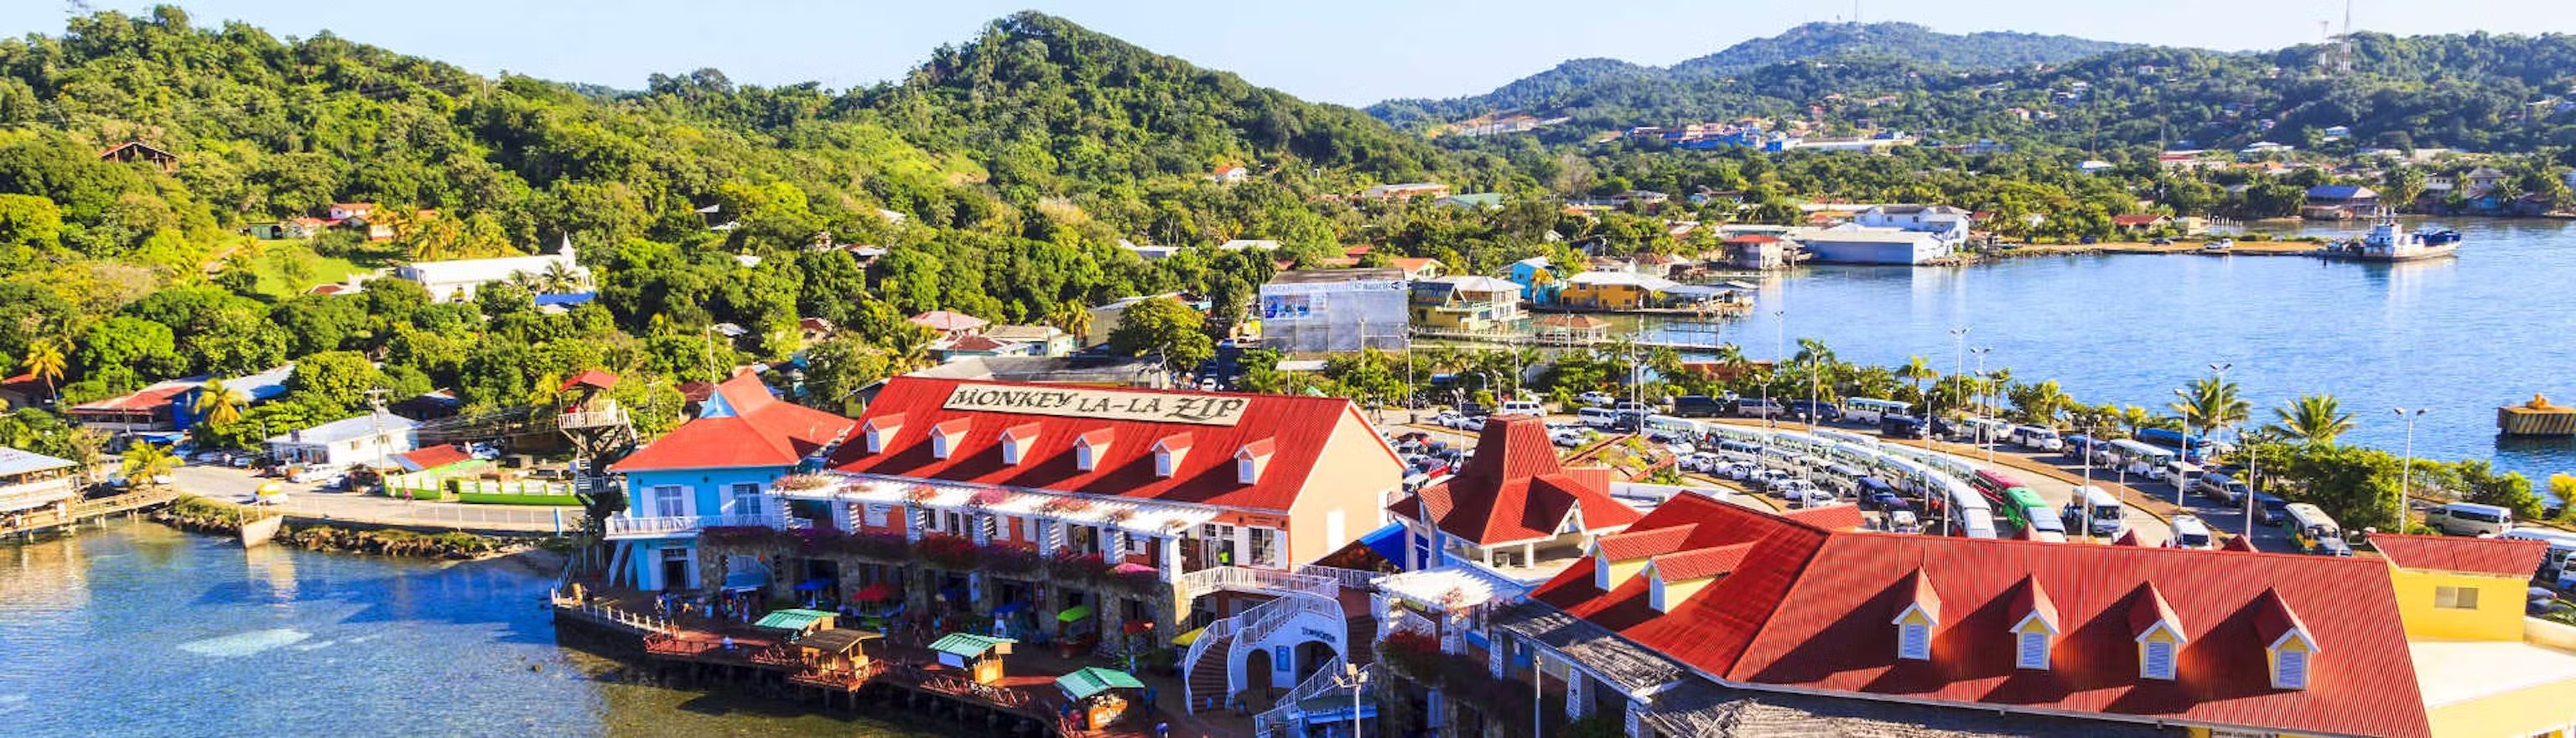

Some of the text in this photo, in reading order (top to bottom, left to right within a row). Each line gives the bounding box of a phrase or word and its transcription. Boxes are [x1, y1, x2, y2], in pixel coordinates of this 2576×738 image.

[951, 389, 1244, 421] MONKEY LA-LA ZIP
